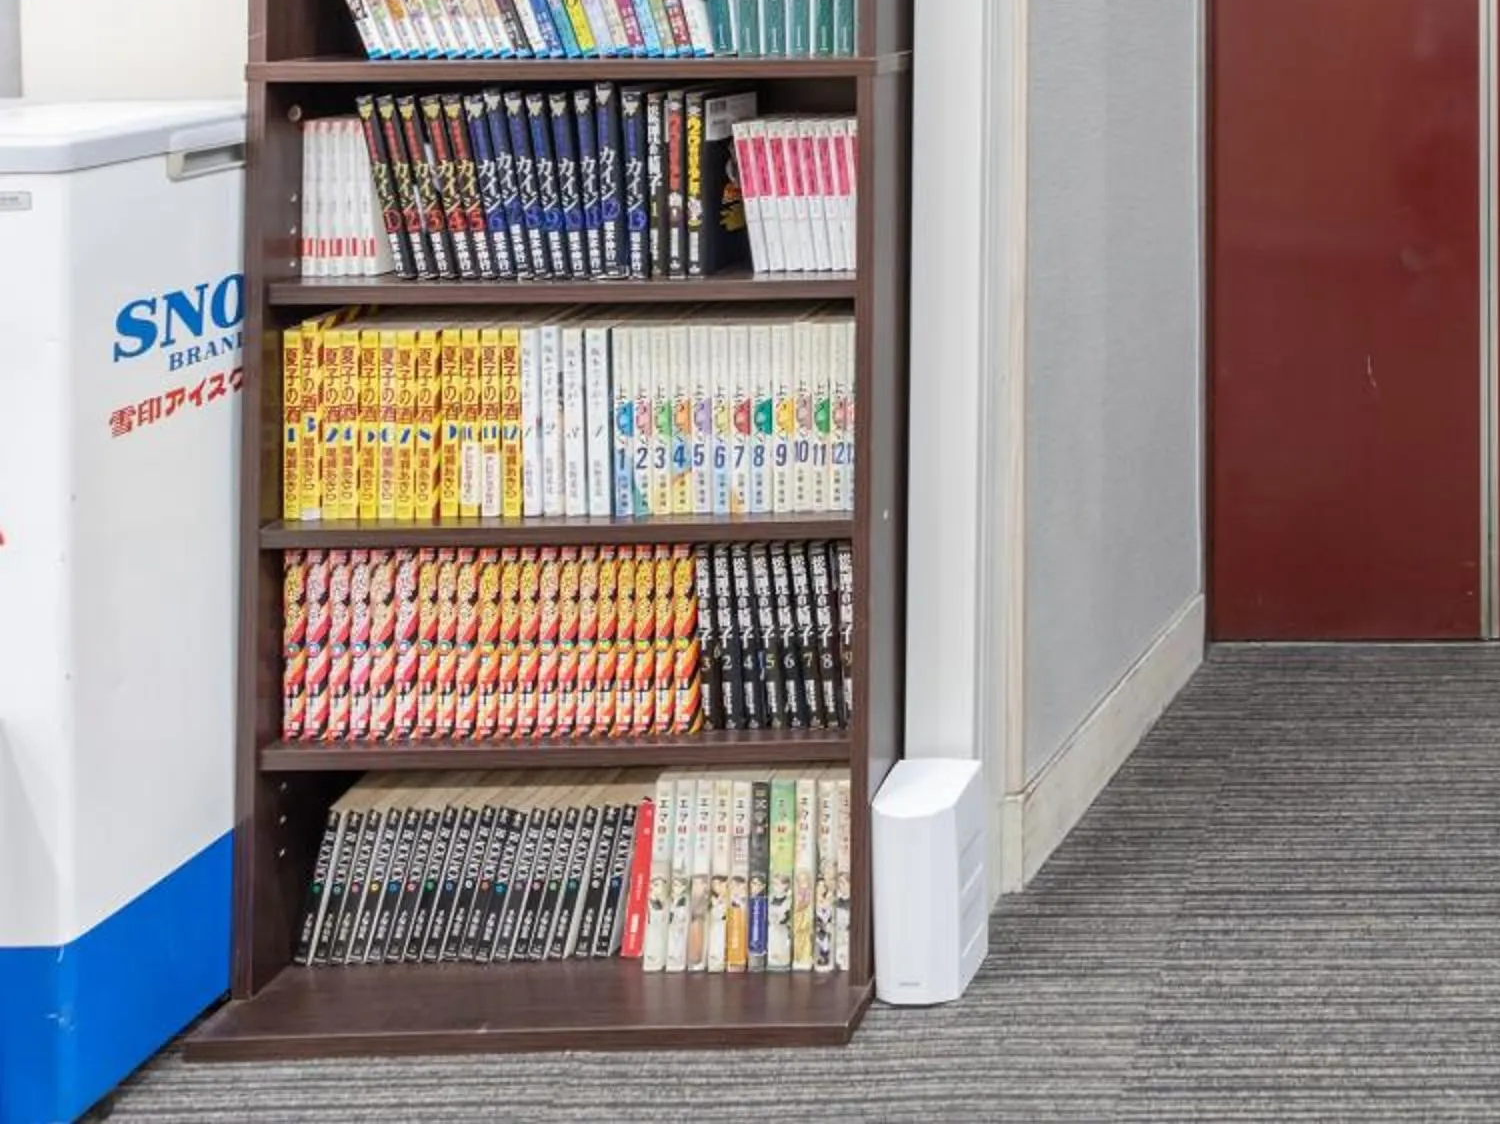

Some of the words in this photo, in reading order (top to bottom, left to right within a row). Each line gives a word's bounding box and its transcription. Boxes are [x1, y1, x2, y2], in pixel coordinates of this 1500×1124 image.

[373, 162, 393, 212] カイジ
[396, 161, 414, 212] カイジ
[416, 160, 436, 213] カイジ
[438, 159, 460, 213] カイジ
[457, 159, 480, 213] カイジ
[478, 159, 502, 213] カイジ
[496, 152, 517, 205] カイジ
[516, 156, 536, 210] カイジ
[537, 157, 557, 211] カイジ
[559, 157, 578, 212] カイジ
[581, 156, 599, 209] カイジ
[600, 146, 616, 201] カイジ
[625, 157, 643, 212] カイジ
[285, 347, 299, 422] 夏子の酒
[301, 336, 317, 413] 夏子の酒
[325, 347, 341, 422] 夏子の酒
[341, 345, 356, 421] 夏子の酒
[360, 348, 377, 422] 夏子の酒
[380, 347, 397, 422] 夏子の酒
[399, 350, 413, 422] 夏子の酒
[417, 348, 433, 422] 夏子の酒
[443, 346, 459, 421] 夏子の酒
[462, 348, 478, 422] 夏子の酒
[482, 345, 499, 421] 夏子の酒
[502, 346, 518, 421] 夏子の酒
[109, 365, 244, 438] 雪印アイスク
[617, 448, 626, 469] 1
[636, 447, 648, 469] 2
[655, 447, 665, 469] 3
[673, 445, 686, 468] 4
[694, 444, 704, 466] 5
[715, 446, 725, 468] 6
[734, 445, 745, 468] 7
[753, 444, 764, 466] 8
[776, 444, 787, 466] 9
[795, 441, 809, 462] 10
[813, 444, 826, 466] 11
[832, 442, 845, 465] 12
[702, 656, 711, 671] 3
[723, 656, 732, 669] 2
[744, 656, 753, 669] 4
[766, 655, 775, 669] 5
[784, 655, 795, 668] 6
[804, 652, 813, 667] 7
[823, 654, 833, 669] 8
[658, 799, 671, 822] エマ
[678, 799, 689, 823] エマ
[699, 797, 708, 820] エマ
